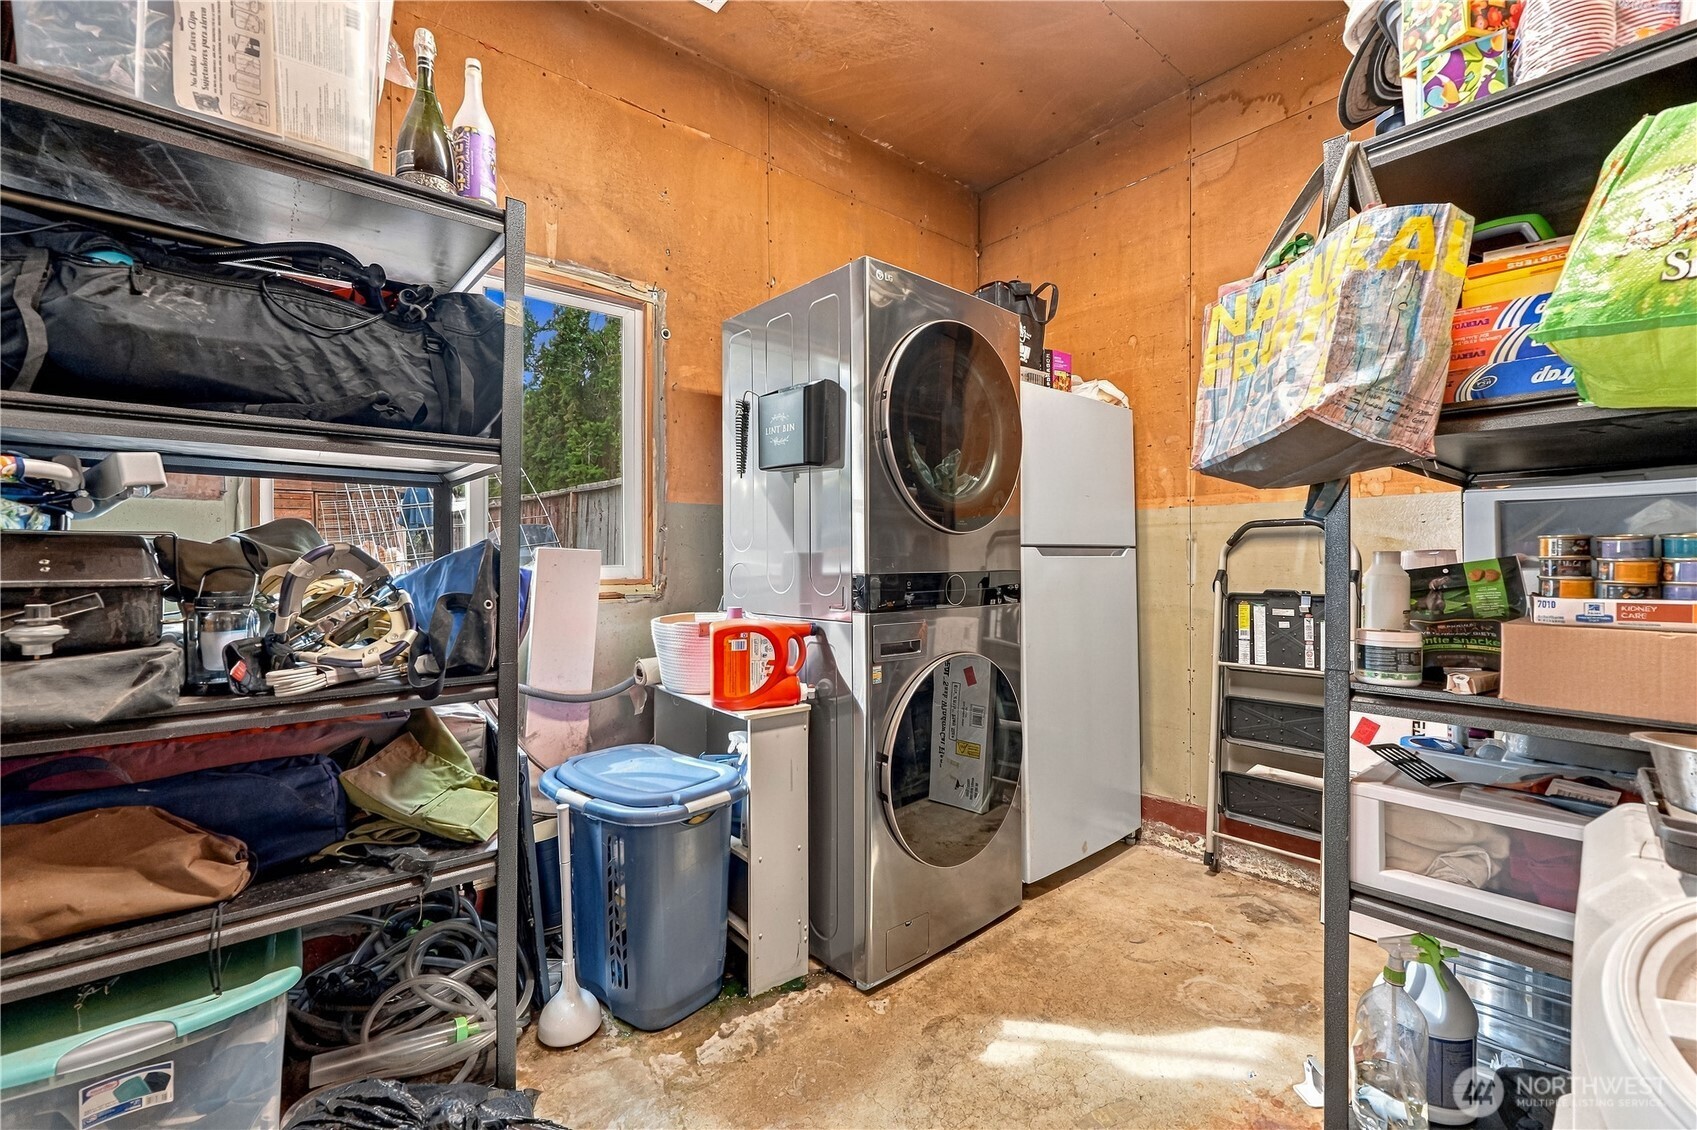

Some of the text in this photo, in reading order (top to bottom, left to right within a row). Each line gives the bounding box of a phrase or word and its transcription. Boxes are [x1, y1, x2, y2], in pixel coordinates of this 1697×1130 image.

[1206, 215, 1467, 345] NATURAL
[765, 423, 795, 436] LINT BIN
[1538, 600, 1556, 609] 7010
[1620, 612, 1647, 620] CARE
